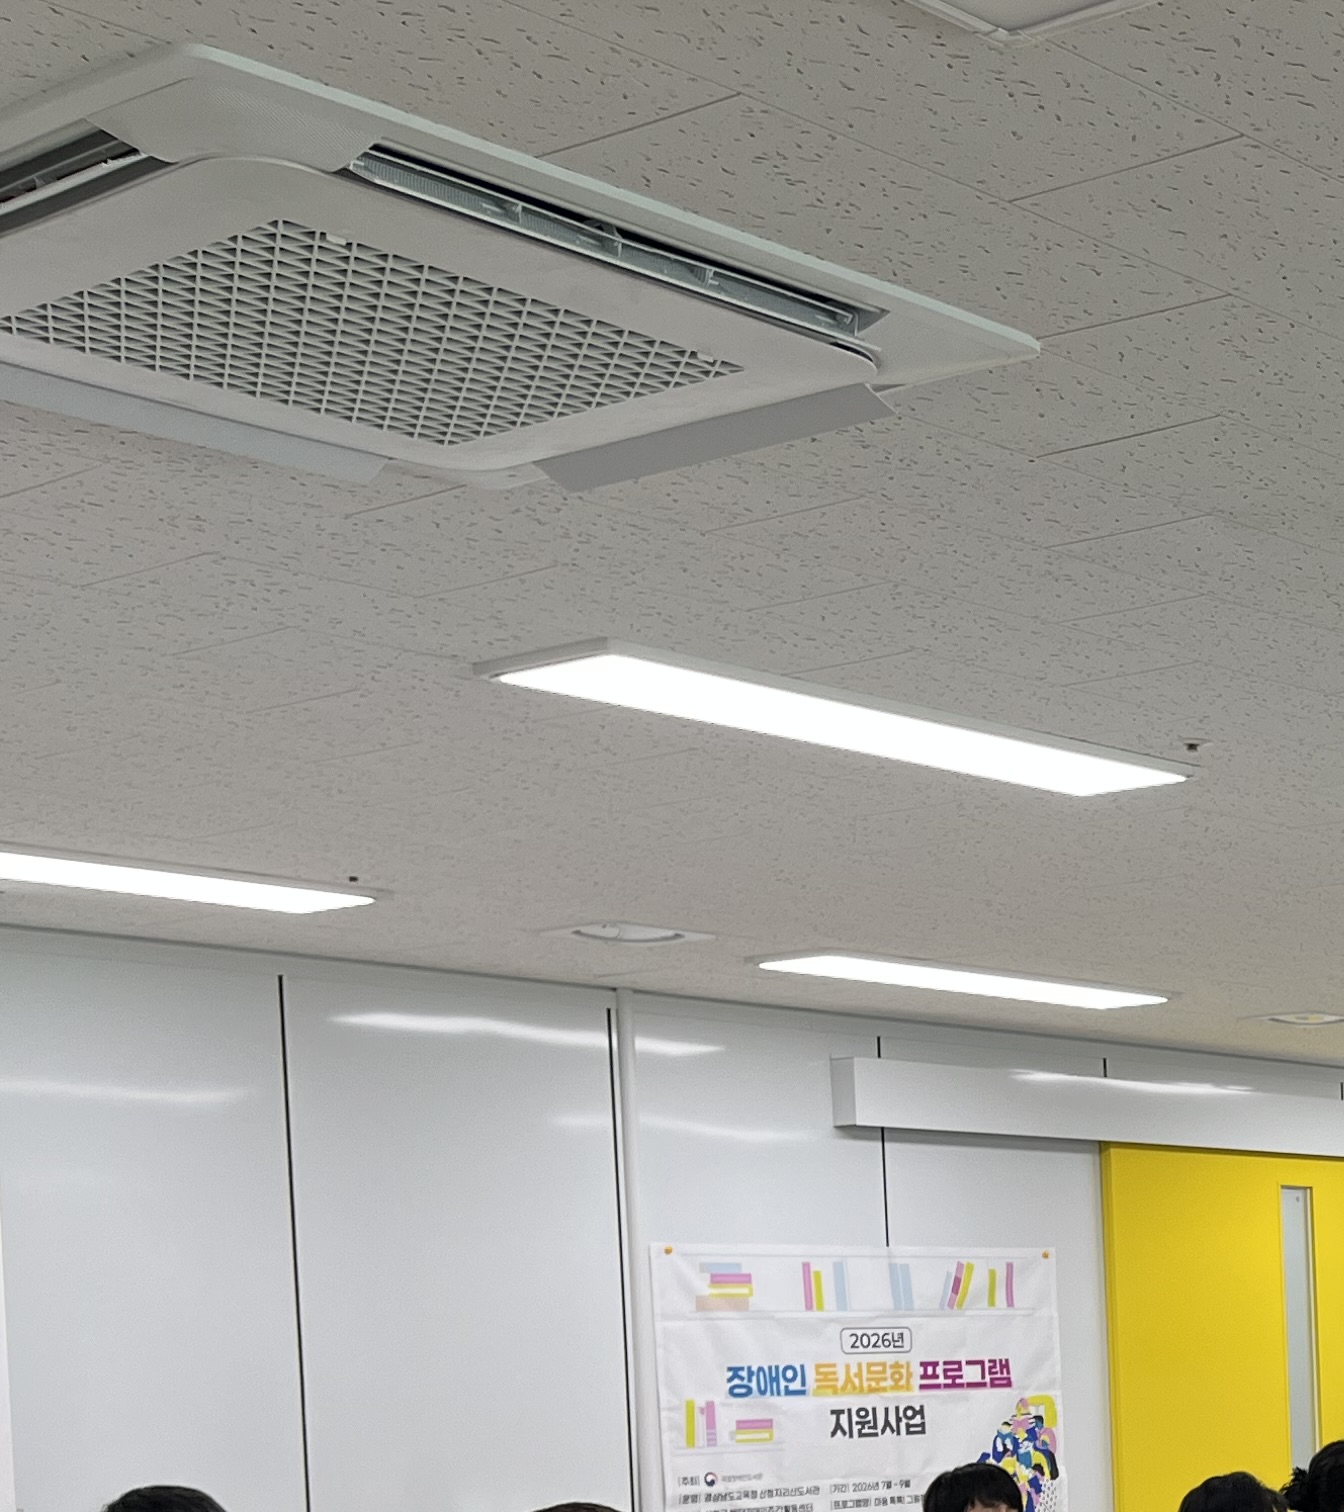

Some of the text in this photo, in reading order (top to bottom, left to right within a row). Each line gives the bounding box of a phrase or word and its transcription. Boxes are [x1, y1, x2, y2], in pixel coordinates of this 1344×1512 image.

[849, 1331, 905, 1349] 2026년
[726, 1358, 1013, 1398] 장애인 독서문화 프로그램
[830, 1404, 927, 1439] 지원사업
